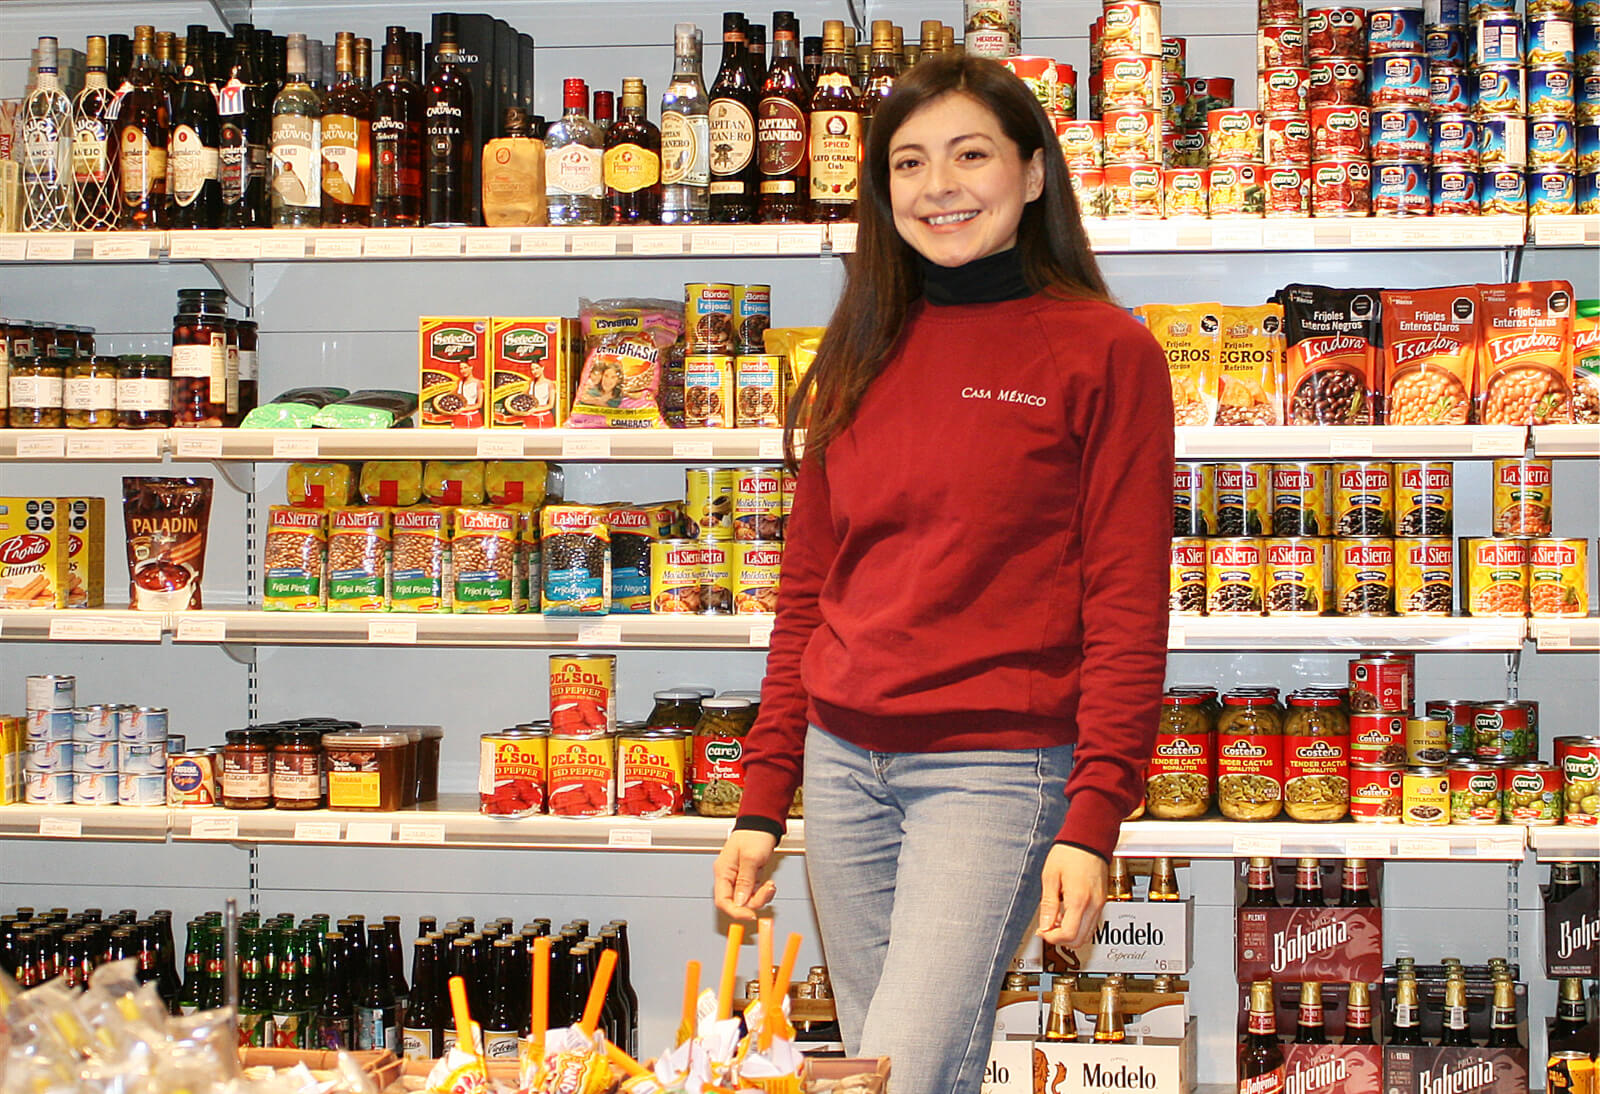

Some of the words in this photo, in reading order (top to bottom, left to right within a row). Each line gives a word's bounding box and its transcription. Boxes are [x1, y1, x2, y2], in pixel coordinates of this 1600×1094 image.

[1313, 311, 1344, 323] Frijoles
[1415, 312, 1446, 323] Frijoles
[1508, 307, 1541, 319] Frijoles
[1301, 320, 1330, 332] Enteros
[1331, 321, 1363, 333] Negros
[1400, 321, 1432, 332] Enteros
[1433, 321, 1460, 332] Claros
[1493, 318, 1527, 329] Enteros
[1528, 317, 1557, 328] Claros
[1224, 341, 1253, 350] Frijoles
[1301, 331, 1366, 363] Isadora
[1395, 333, 1460, 363] Isadora
[1491, 328, 1559, 363] Isadora
[1164, 350, 1210, 362] GROS
[1219, 350, 1273, 363] EGROS
[961, 387, 992, 399] CASA
[1342, 471, 1355, 486] La
[1356, 471, 1387, 487] Sierra
[1405, 473, 1418, 487] La
[1419, 472, 1450, 488] Sierra
[1503, 468, 1517, 482] La
[1518, 468, 1549, 483] Sierra
[739, 479, 751, 491] La
[753, 479, 776, 491] Sierra
[274, 513, 288, 525] La
[289, 513, 318, 526] Sierra
[336, 513, 350, 525] La
[351, 512, 379, 527] Sierra
[394, 513, 409, 525] La
[463, 513, 477, 528] La
[621, 511, 648, 525] Sierra
[132, 517, 198, 534] PALADIN
[4, 537, 50, 562] Pronto
[1212, 549, 1226, 564] La
[1227, 548, 1258, 564] Sierra
[1281, 548, 1312, 563] Sierra
[746, 552, 759, 565] La
[1352, 549, 1366, 564] La
[1367, 549, 1393, 564] Sierra
[1481, 550, 1496, 563] La
[1537, 549, 1573, 564] Sierra
[1, 562, 47, 580] Churros
[272, 582, 291, 595] Frijol
[336, 583, 355, 596] Frijol
[395, 583, 414, 595] Frijol
[415, 584, 431, 594] Pinto
[464, 586, 483, 597] Frijol
[573, 673, 603, 686] SOL
[565, 686, 601, 698] PEPPER
[708, 747, 740, 759] carey
[1313, 742, 1326, 751] La
[511, 758, 540, 772] SOL
[552, 756, 576, 770] DEL
[577, 757, 607, 772] SOL
[638, 758, 670, 773] SOL
[1290, 760, 1317, 768] TENDER
[1318, 760, 1347, 768] CACTUS
[504, 769, 539, 782] PEPPER
[569, 770, 606, 782] PEPPER
[633, 769, 668, 782] PEPPER
[1471, 780, 1496, 790] carey
[1515, 780, 1540, 790] carey
[1092, 921, 1164, 946] Modelo
[1271, 918, 1349, 973] Bohemia
[1552, 918, 1600, 969] Bohe
[1107, 948, 1147, 962] Especial
[983, 1061, 1010, 1084] elo
[1083, 1063, 1157, 1091] Modelo
[1285, 1054, 1346, 1094] ohemia
[1418, 1057, 1494, 1094] Bohemia
